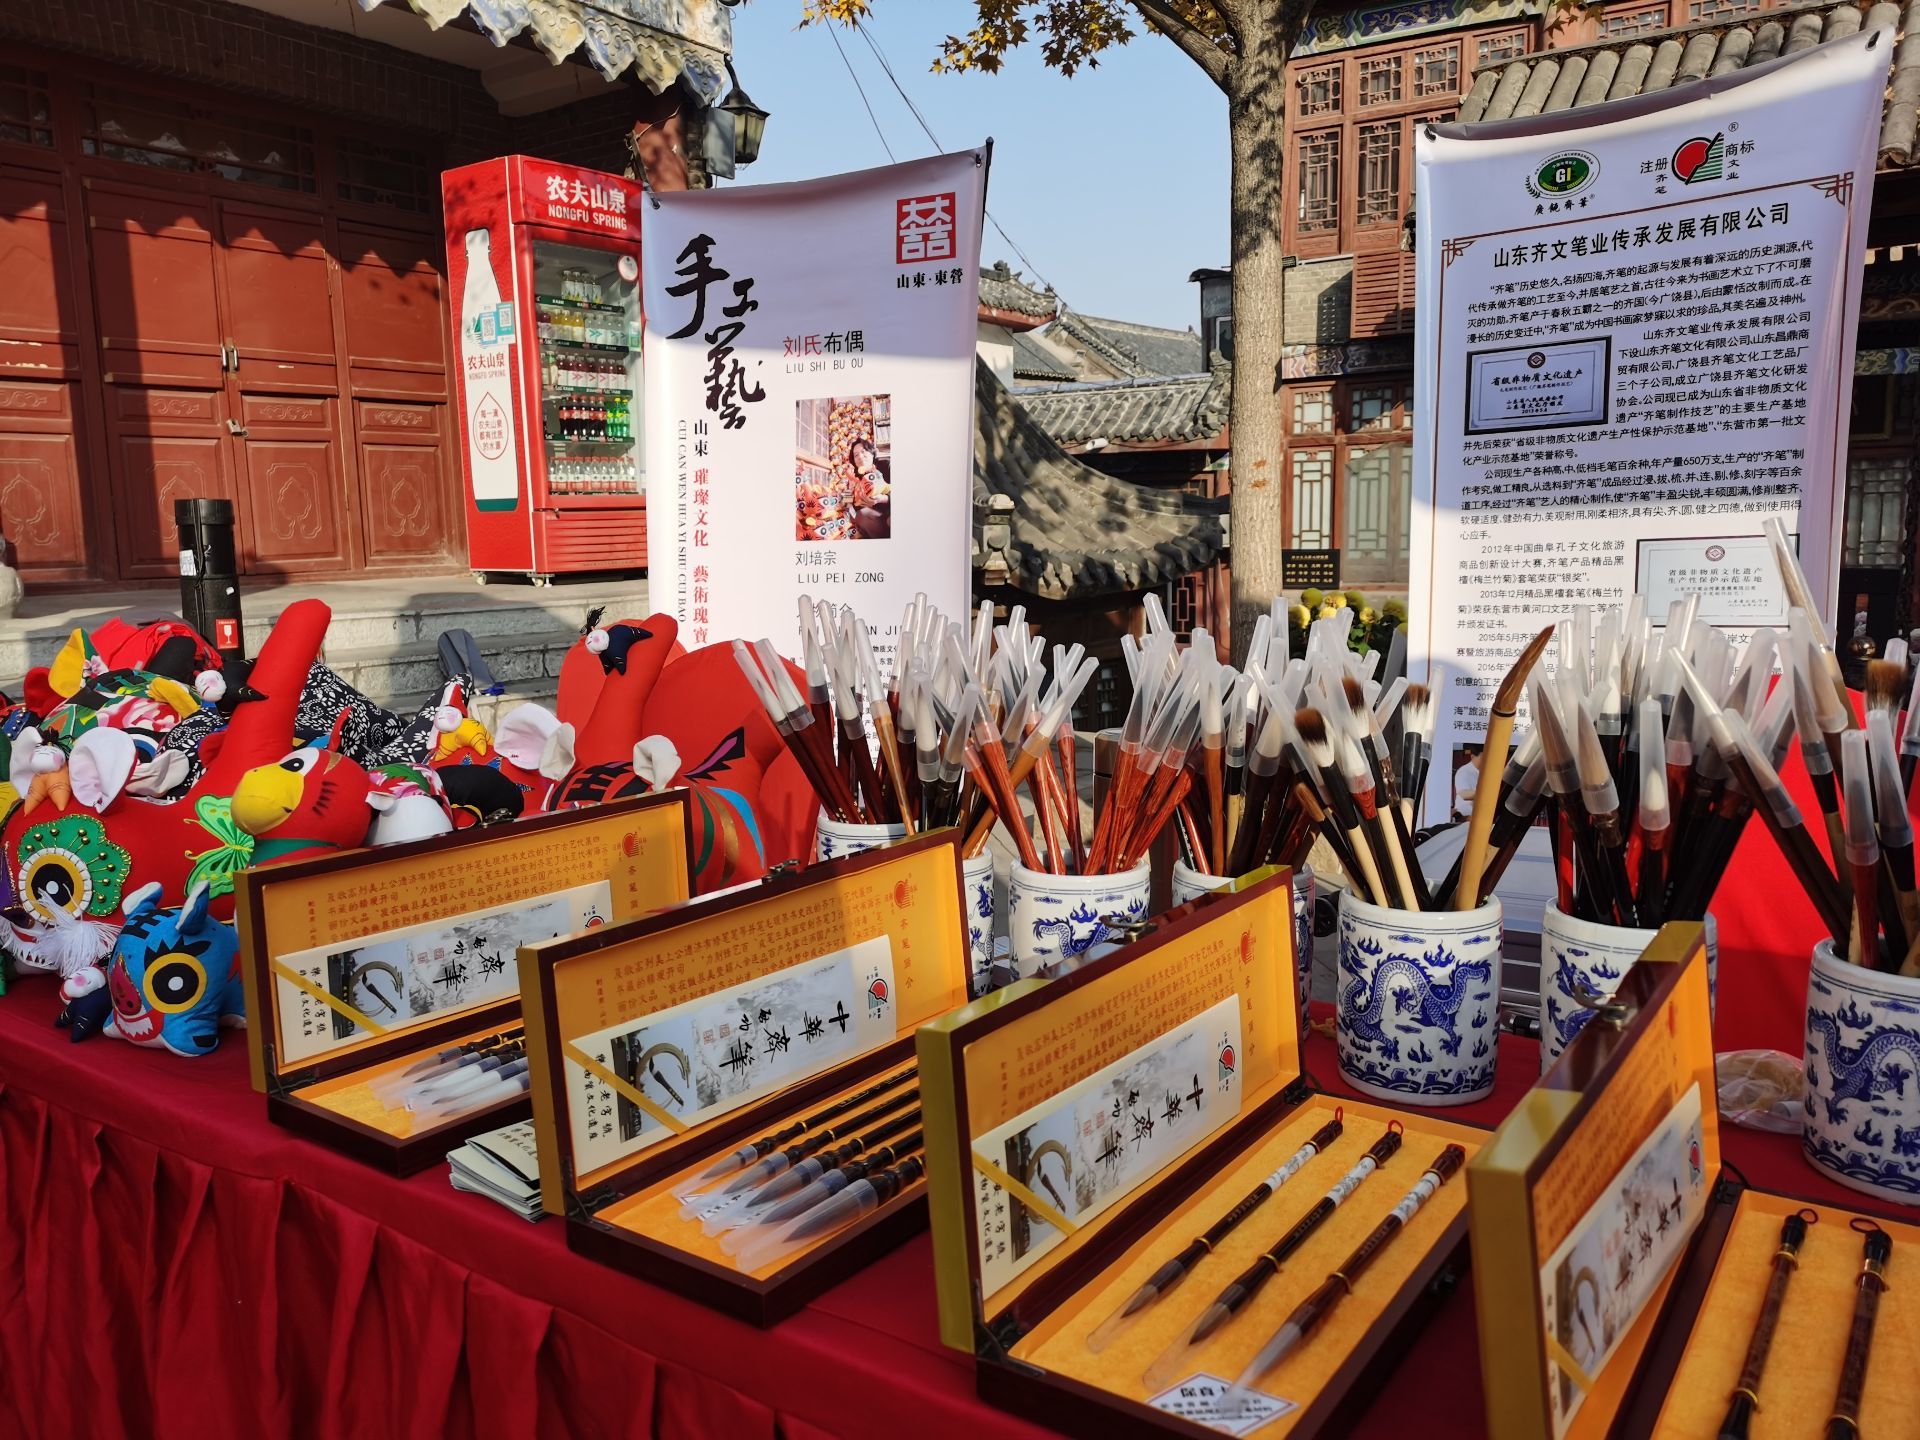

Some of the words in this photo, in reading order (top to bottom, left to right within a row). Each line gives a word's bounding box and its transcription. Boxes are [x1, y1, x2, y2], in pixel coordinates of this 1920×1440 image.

[1725, 139, 1755, 157] 商标
[1640, 157, 1668, 174] 注册
[546, 175, 627, 214] 农夫山泉
[548, 204, 589, 223] NONGFU
[593, 211, 627, 231] SPRING
[1494, 202, 1789, 268] 山东齐文笔业传承发展有限公司
[1643, 311, 1811, 341] 山东齐文笔业传承发展有限公司
[783, 330, 864, 358] 刘氏布偶
[1618, 328, 1810, 359] 下设山东齐笔文化有限公司、山东昌鼎商
[467, 352, 505, 371] 农夫山泉
[786, 363, 804, 375] LIU
[810, 361, 827, 372] SHI
[833, 359, 845, 371] BU
[851, 357, 864, 368] OU
[1617, 346, 1810, 376] 贸有限公司、广饶县齐笔文化工艺品厂
[1616, 380, 1808, 407] 协会。公司现已成为山东省非物质文化
[679, 419, 687, 440] CUI
[679, 444, 687, 470] CAN
[679, 473, 687, 500] WEN
[678, 546, 687, 570] SHU
[795, 550, 836, 566] 刘培宗
[1481, 540, 1625, 554] 2012年中国曲阜孔子文化旅游
[678, 573, 687, 594] CUI
[797, 573, 819, 584] LIU
[826, 572, 846, 584] PEI
[854, 571, 885, 584] ZONG
[678, 598, 687, 623] BAO
